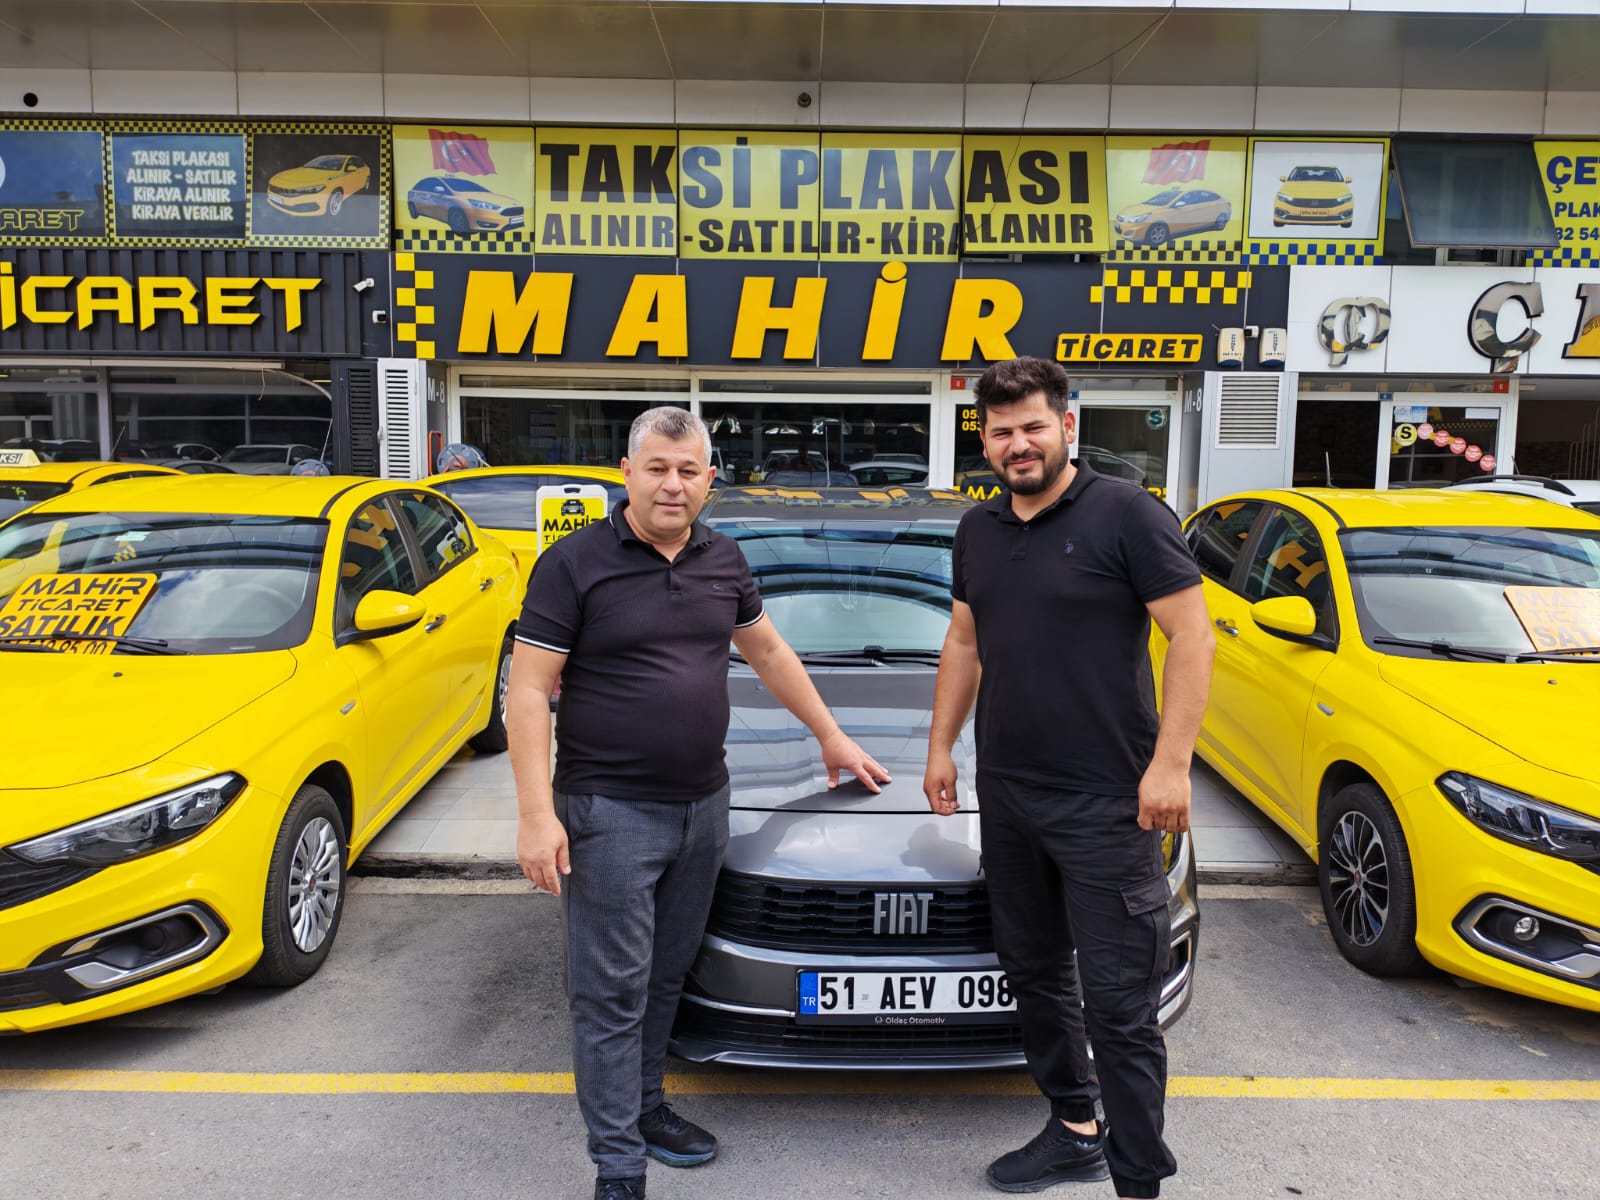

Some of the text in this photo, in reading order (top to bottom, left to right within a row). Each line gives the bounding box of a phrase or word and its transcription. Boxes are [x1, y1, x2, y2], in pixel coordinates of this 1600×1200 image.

[132, 150, 230, 167] TAKSİ PLAKASI
[126, 168, 172, 184] ALINIR
[185, 169, 237, 185] SATILIR
[540, 137, 1090, 212] TAKSİ PLAKASI
[1546, 155, 1600, 193] ÇE
[133, 186, 231, 202] KİRAYA ALINIR
[132, 204, 234, 221] KİRAYA VERİLİR
[457, 261, 1024, 361] MAHİR
[1061, 334, 1199, 360] TİCARET
[1184, 387, 1203, 413] M-8
[873, 892, 934, 935] FIAT
[802, 996, 816, 1007] TR
[820, 974, 1016, 1010] 51 AEV 098
